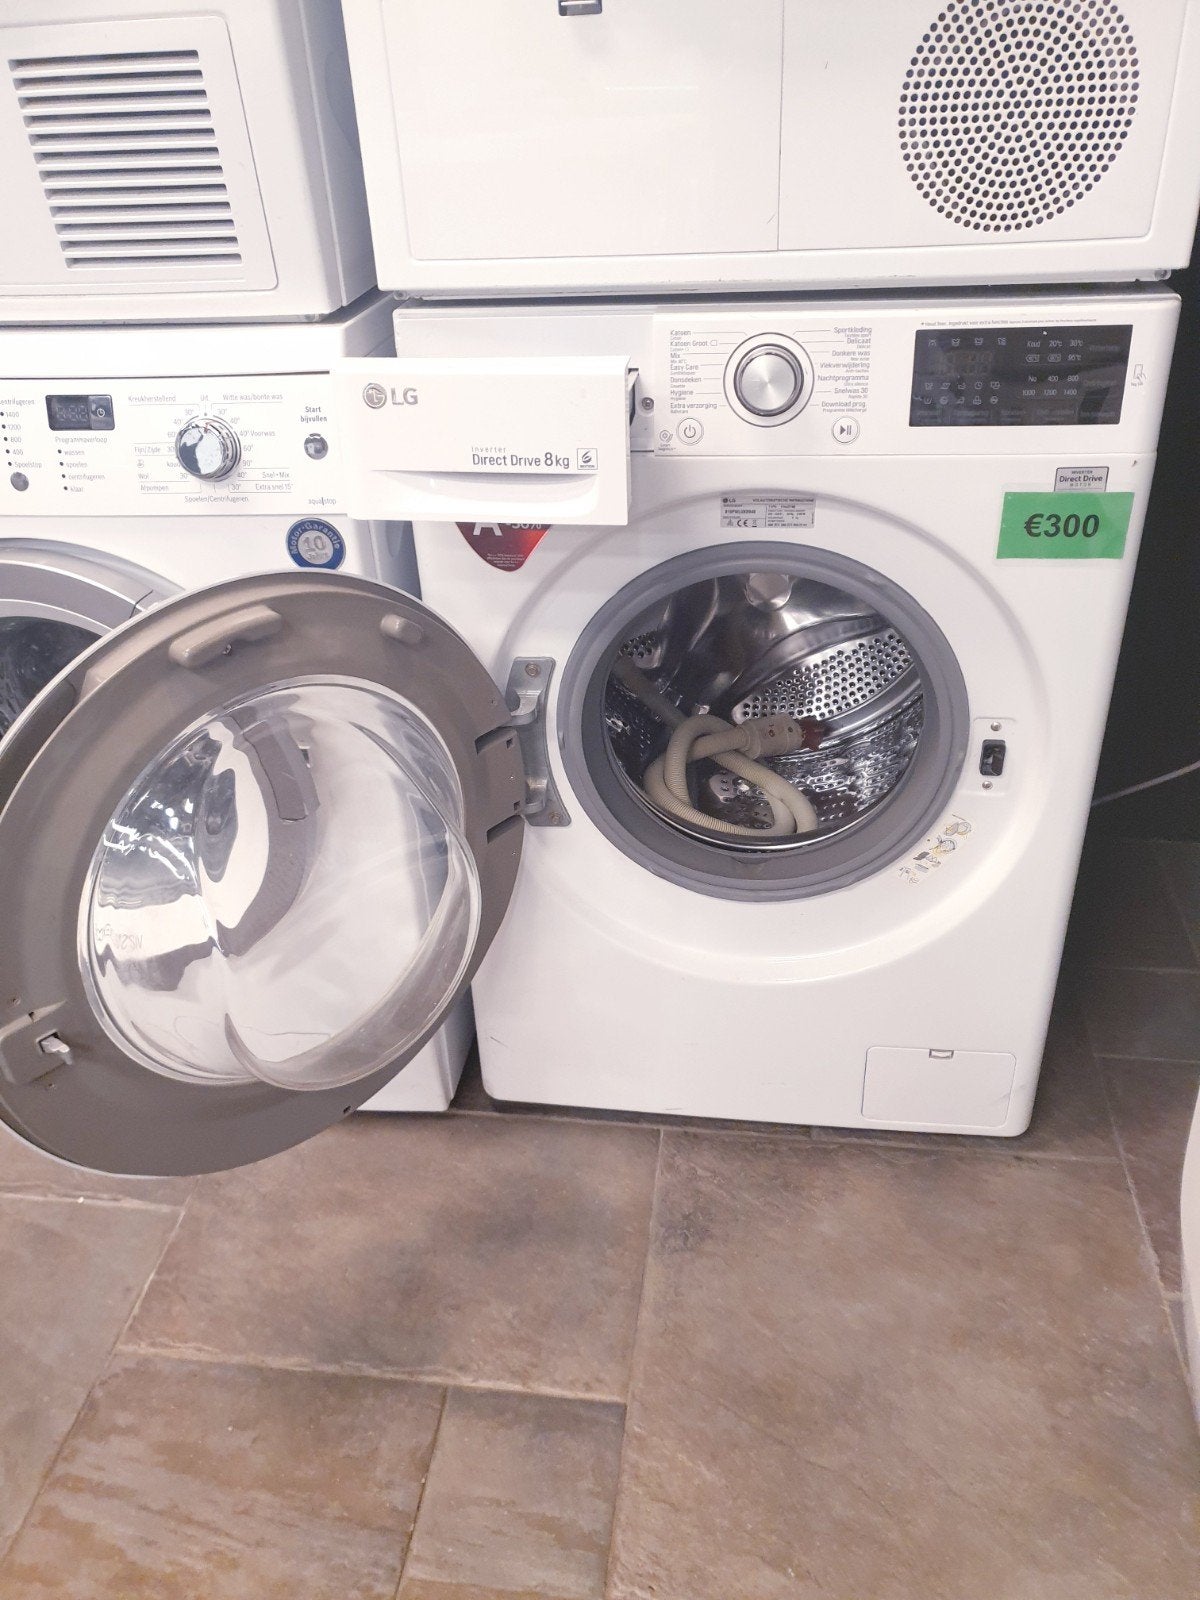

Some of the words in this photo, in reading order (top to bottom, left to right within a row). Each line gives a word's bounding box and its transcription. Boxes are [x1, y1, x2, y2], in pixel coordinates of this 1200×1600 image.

[833, 326, 872, 334] Sportkleding
[670, 364, 685, 372] Easy
[817, 374, 870, 382] Nachtprogramma
[390, 388, 418, 406] LG
[822, 400, 852, 408] Download
[300, 415, 328, 424] bijvullen
[54, 436, 108, 444] Programmaverloop
[472, 446, 507, 454] Inverter
[472, 454, 508, 466] Direct
[510, 454, 541, 466] Drive
[1059, 474, 1082, 483] Direct
[1082, 474, 1104, 482] Drive
[184, 496, 249, 504] Spoelen/Centrifugeren
[1024, 513, 1100, 538] €300
[303, 536, 326, 552] 10
